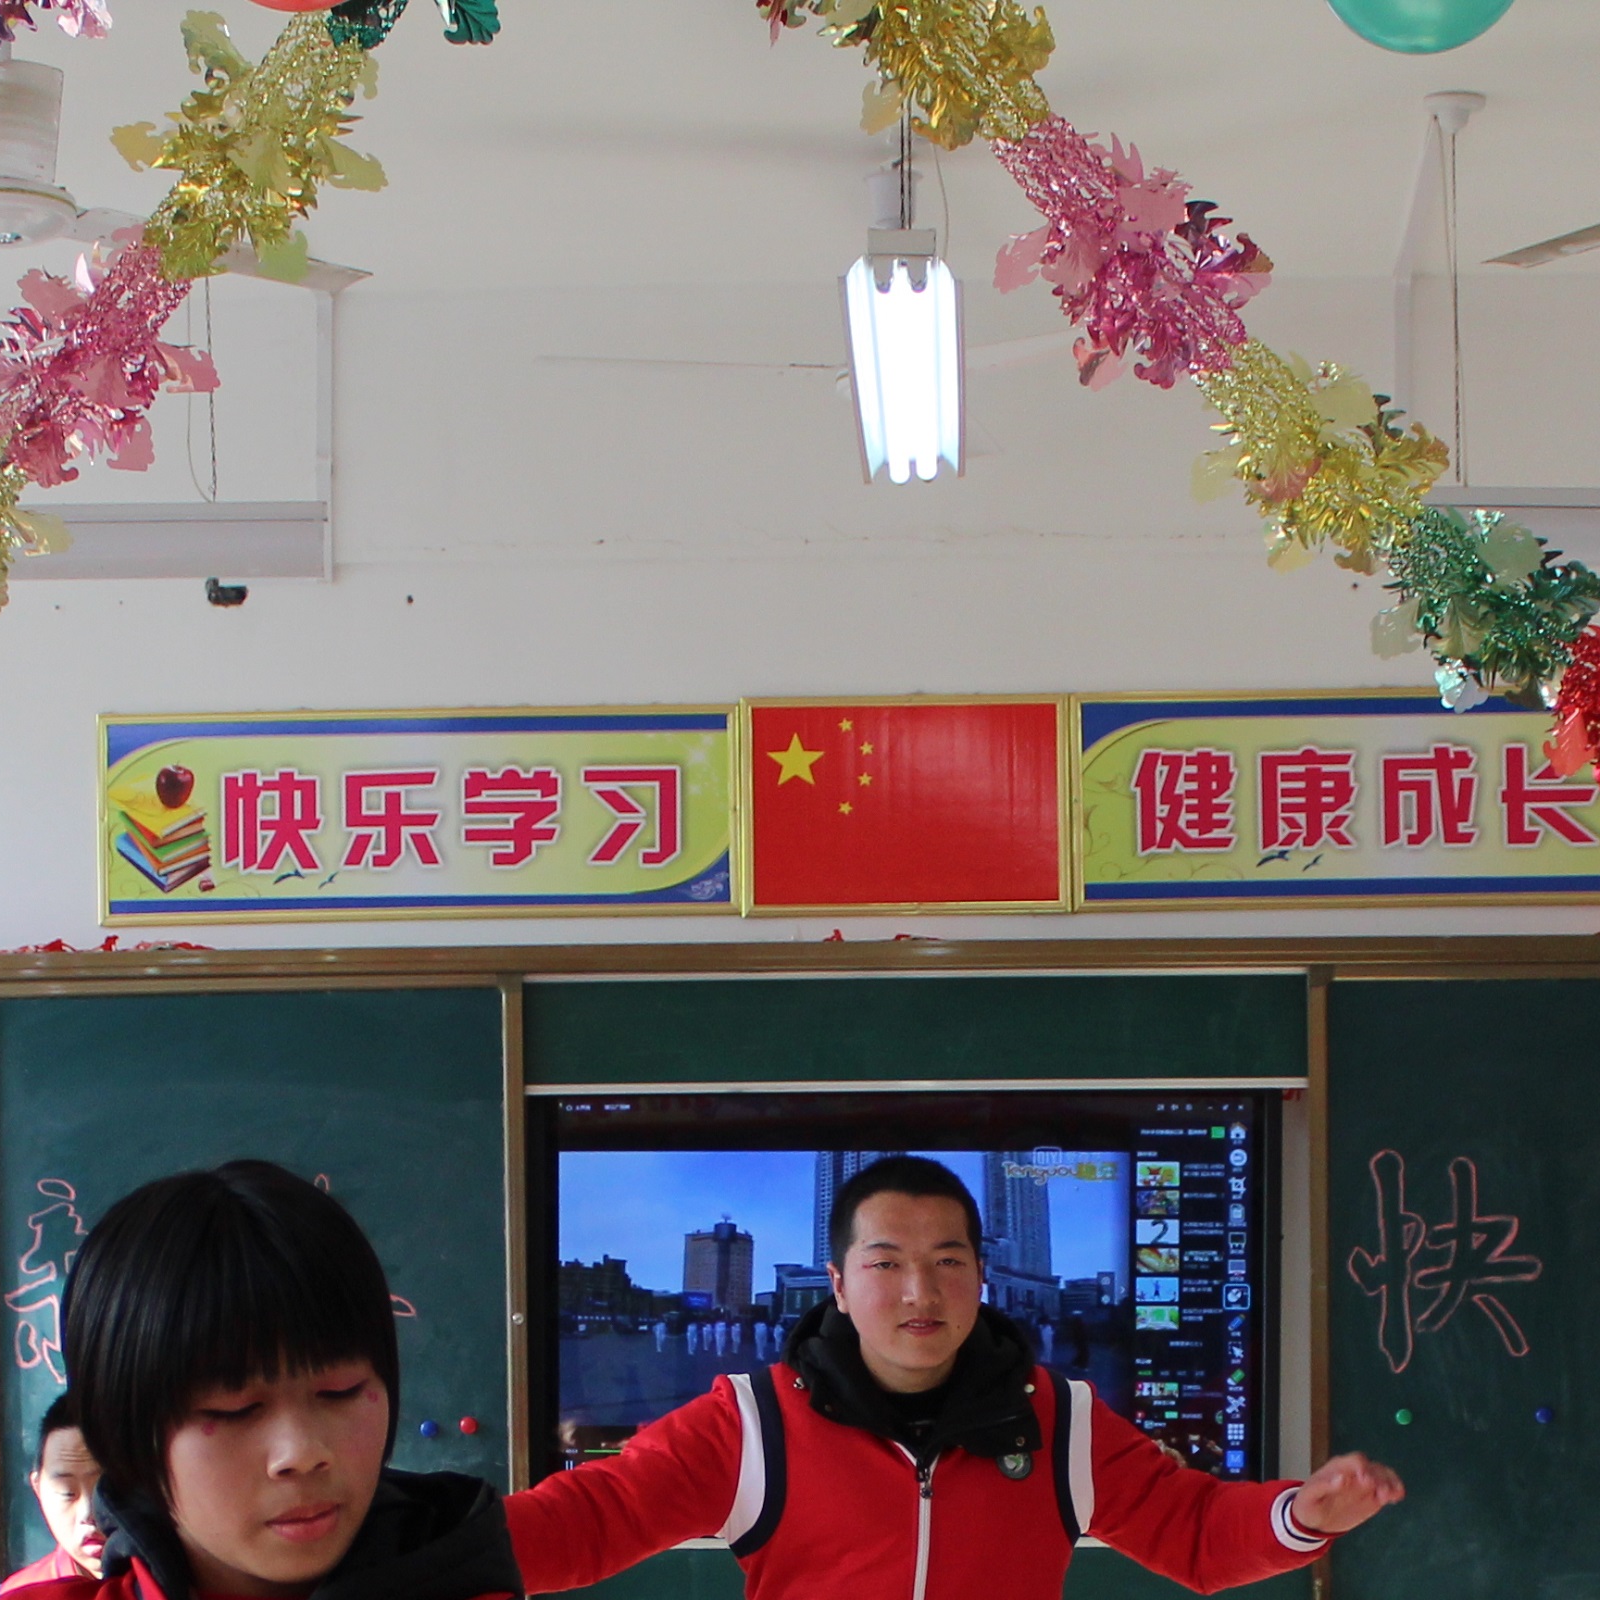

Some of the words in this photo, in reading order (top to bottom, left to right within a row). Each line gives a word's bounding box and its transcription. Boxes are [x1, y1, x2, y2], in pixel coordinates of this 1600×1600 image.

[222, 764, 683, 873] 快乐学习
[1132, 743, 1600, 855] 健康成长
